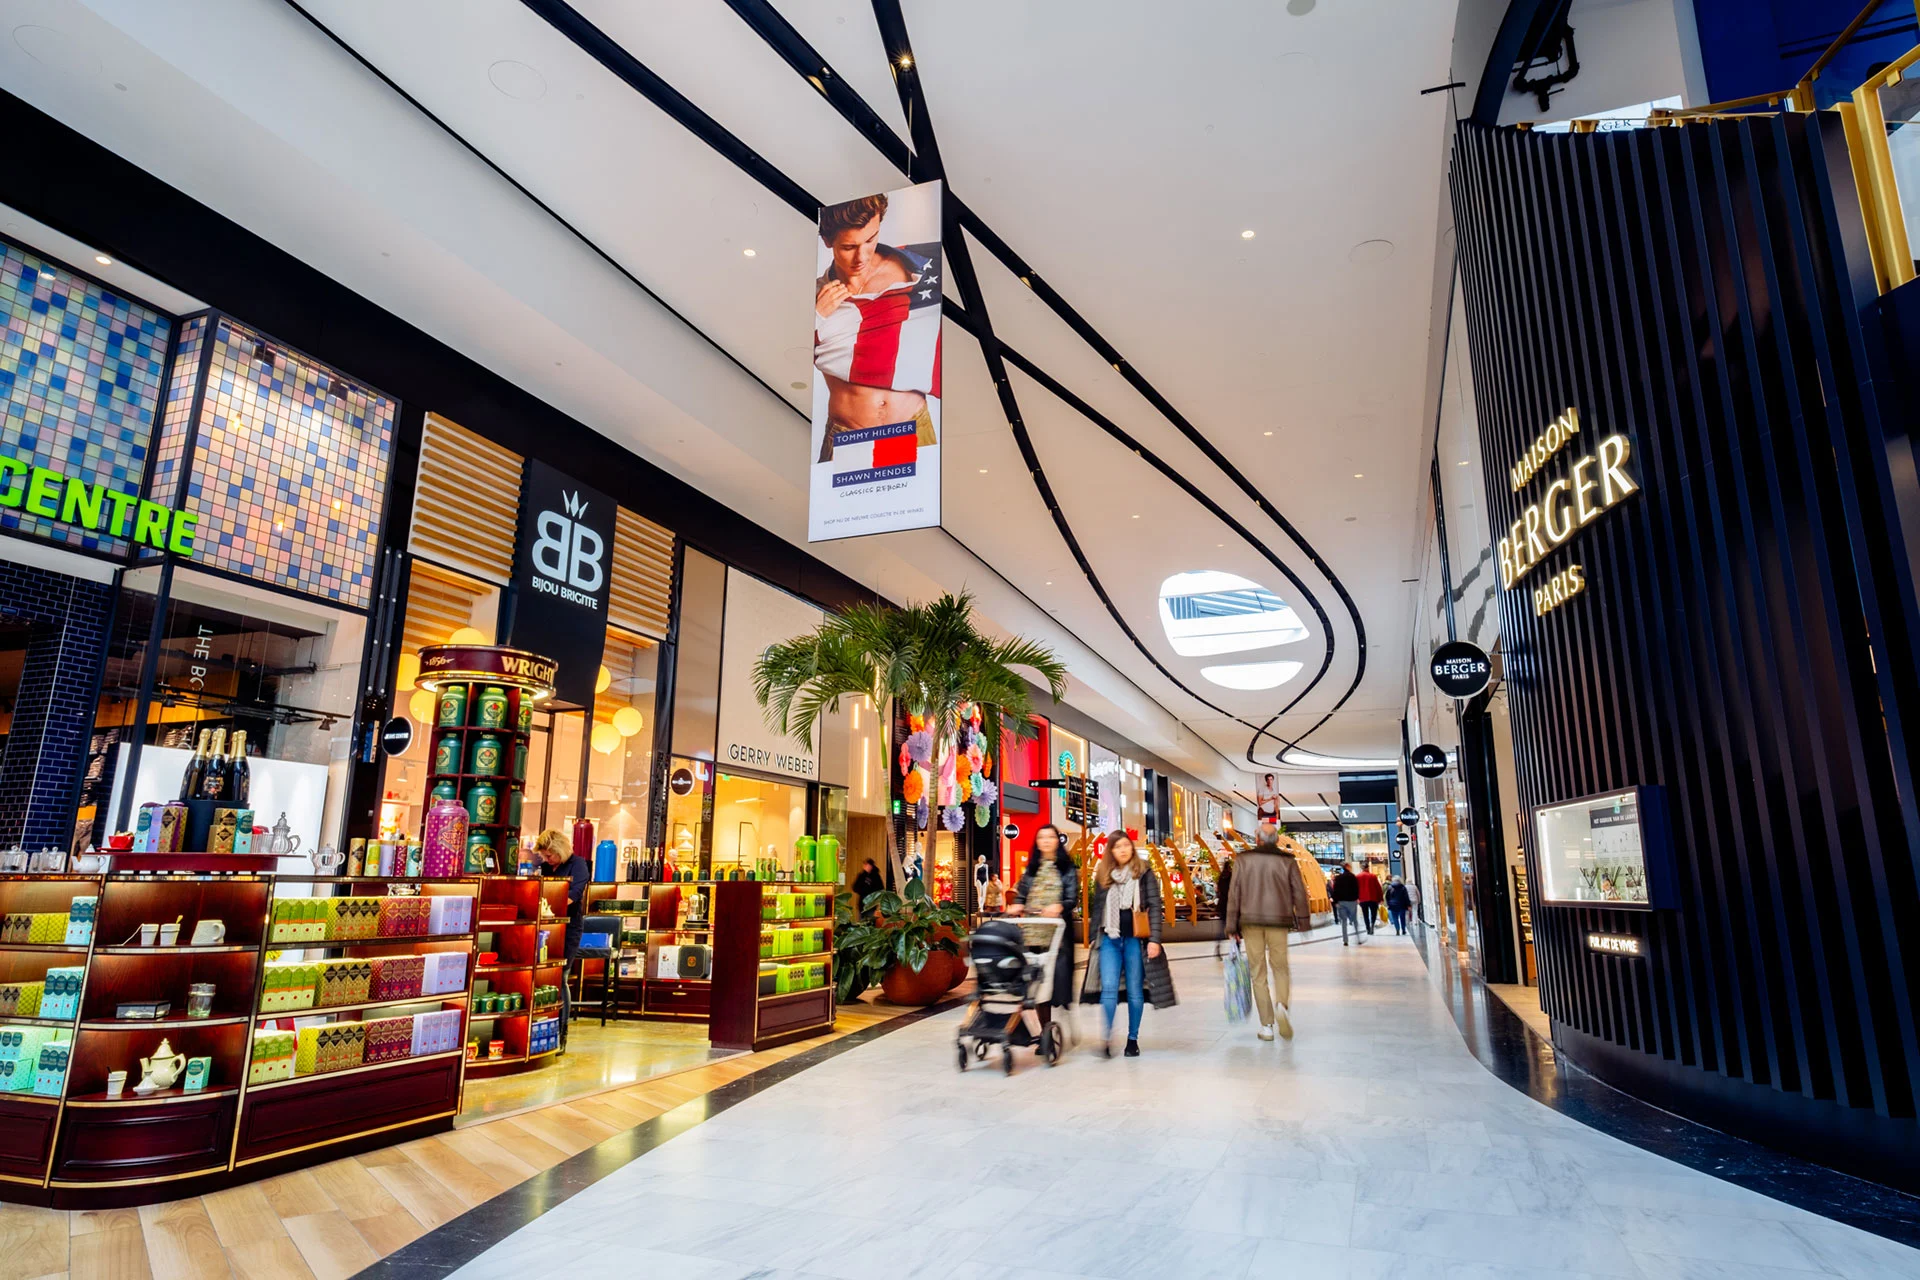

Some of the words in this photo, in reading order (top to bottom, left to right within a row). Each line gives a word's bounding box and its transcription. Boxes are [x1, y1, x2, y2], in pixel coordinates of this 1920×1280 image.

[836, 431, 869, 443] TOMMY
[872, 424, 914, 437] HILFIGER
[1511, 406, 1580, 492] MAISON
[836, 472, 870, 484] SHAWN
[874, 466, 912, 478] MENDES
[839, 487, 873, 498] CLASSICS
[875, 481, 908, 492] REBORN
[0, 454, 199, 556] CENTRE
[1498, 434, 1640, 591] BERGER
[531, 576, 559, 595] BIJOU
[560, 586, 598, 610] BRIGITTE
[1535, 564, 1586, 616] PARIS
[1434, 662, 1486, 675] BERGER
[1446, 657, 1472, 665] MAISON
[728, 743, 771, 766] GERRY
[775, 752, 814, 775] WEBER
